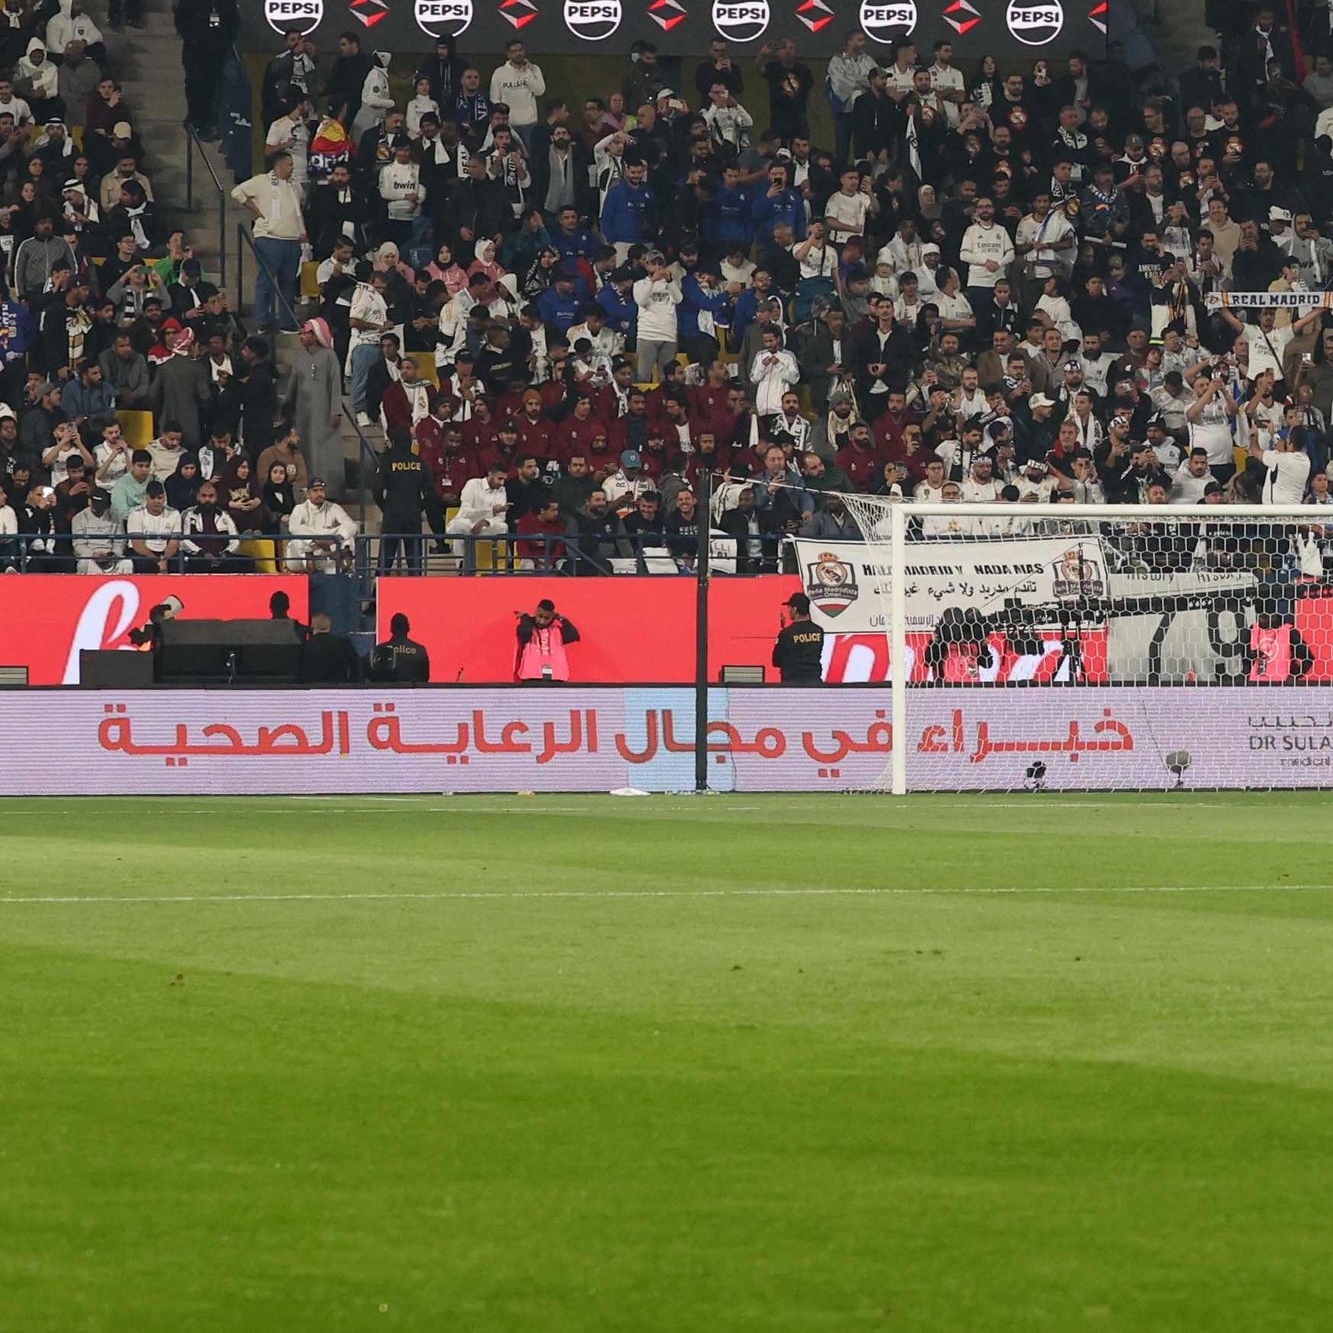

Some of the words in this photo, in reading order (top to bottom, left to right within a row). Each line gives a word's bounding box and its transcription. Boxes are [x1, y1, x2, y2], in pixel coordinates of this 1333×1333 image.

[269, 2, 319, 15] PEPSI
[419, 4, 469, 17] PEPSI
[568, 5, 618, 18] PEPSI
[716, 7, 766, 20] PEPSI
[864, 9, 913, 22] PEPSI
[1010, 10, 1060, 23] PEPSI
[393, 180, 416, 191] bwin
[1232, 295, 1265, 305] REAL
[1270, 294, 1320, 305] MADRID
[391, 461, 421, 471] POLICE
[974, 564, 1012, 575] NADA
[1013, 563, 1044, 575] MAS
[793, 633, 821, 644] POLICE
[393, 645, 417, 655] olice
[99, 703, 350, 766] الصحية
[367, 703, 598, 764] الرعاية
[615, 708, 787, 764] مجال
[918, 708, 1133, 763] خبراء
[802, 709, 893, 778] في
[1249, 735, 1276, 750] DR
